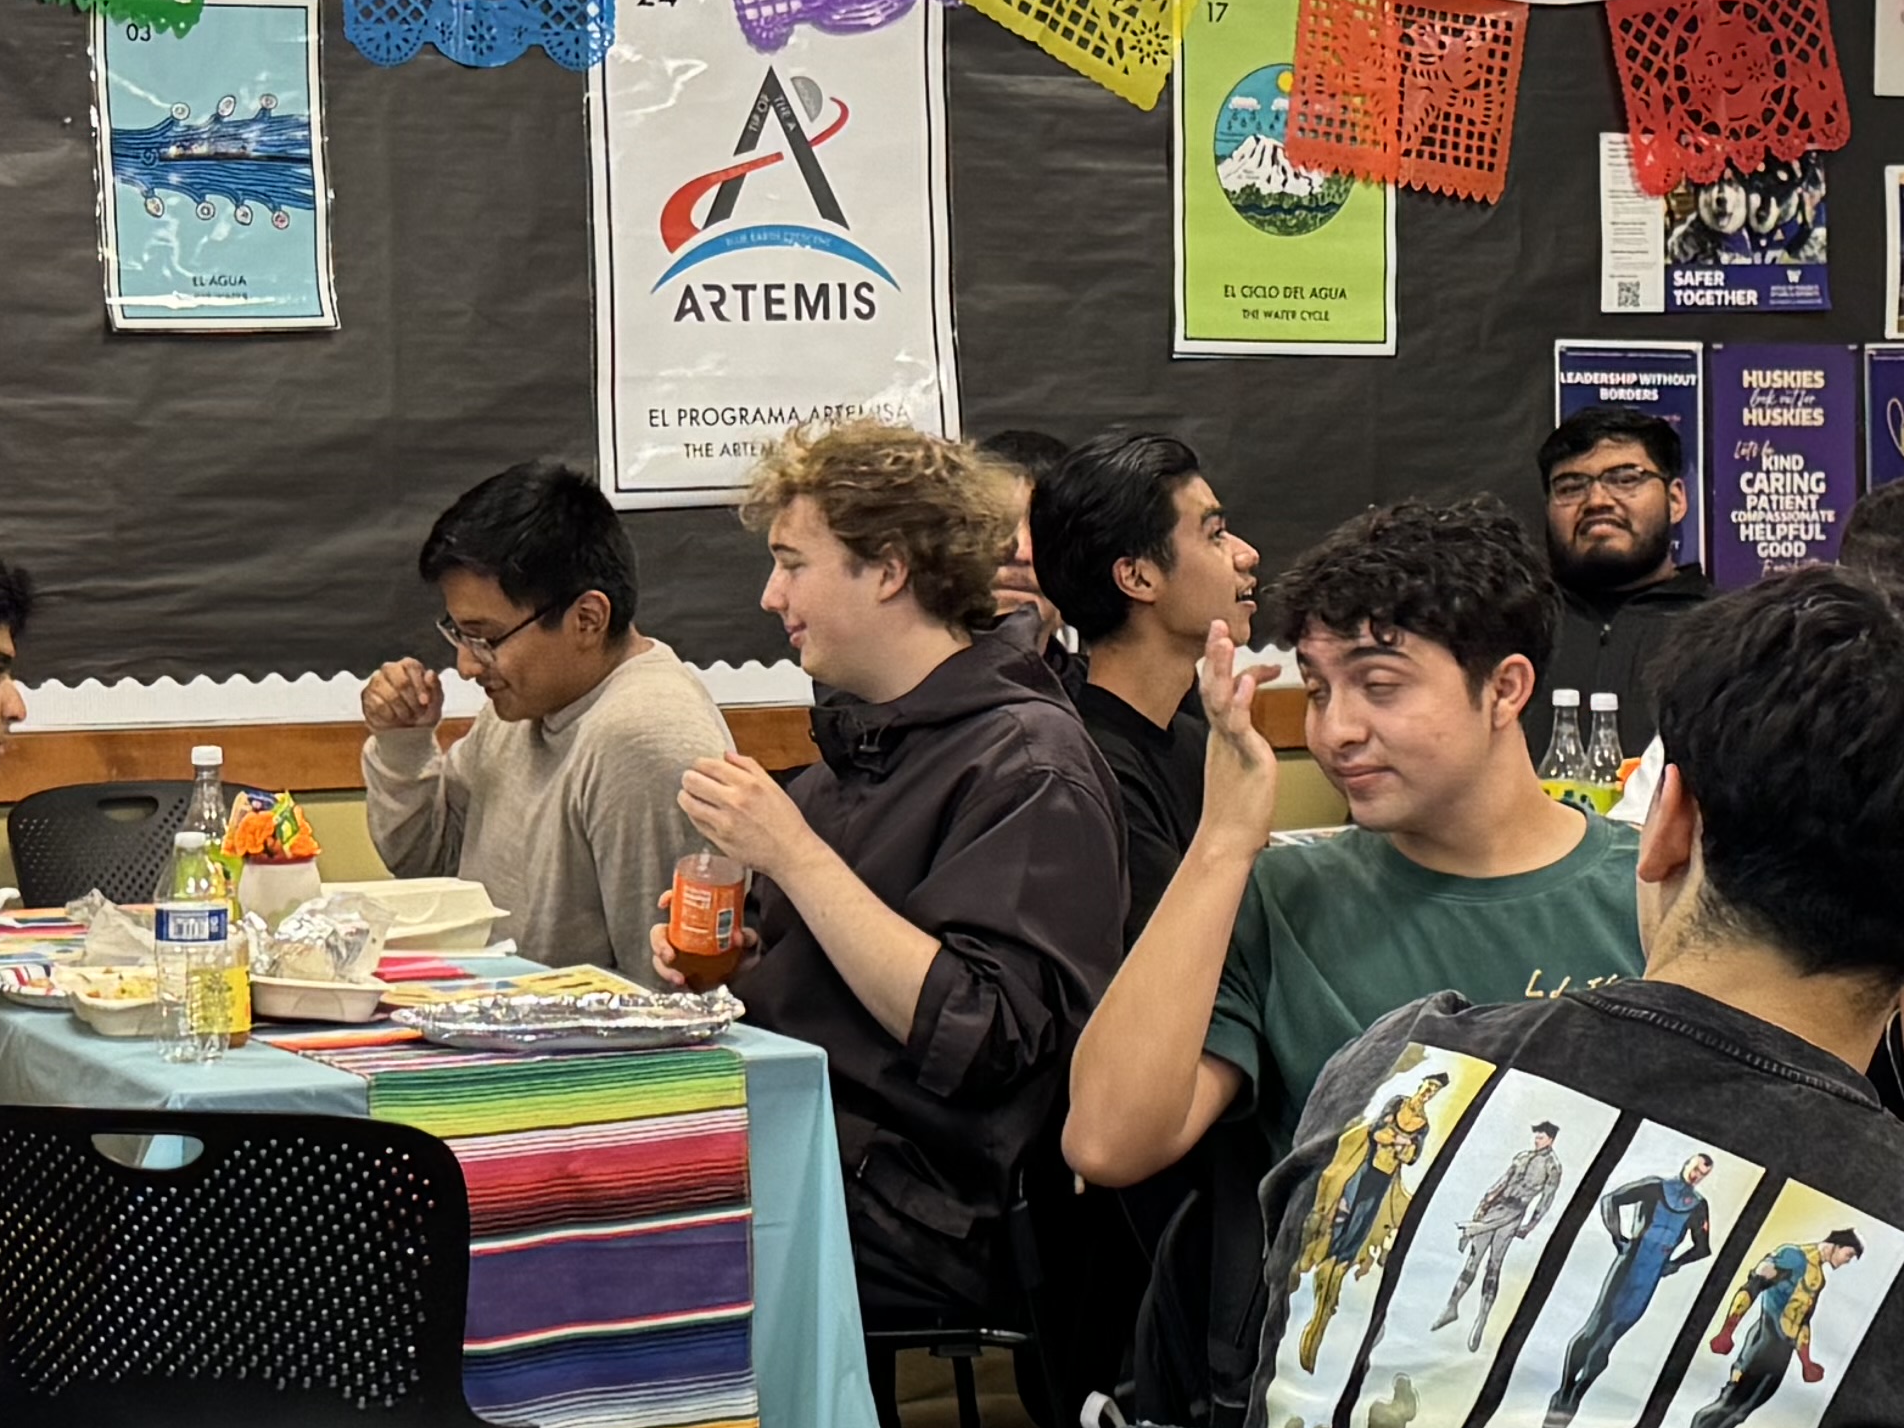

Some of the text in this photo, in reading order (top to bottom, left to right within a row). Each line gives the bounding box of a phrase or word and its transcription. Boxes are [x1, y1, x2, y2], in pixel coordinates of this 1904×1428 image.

[1207, 1, 1229, 24] 17
[126, 23, 152, 42] 03
[208, 275, 247, 287] AGUA
[1673, 270, 1725, 286] SAFER
[1224, 284, 1347, 300] EL CICLO DEL AGUA
[1673, 289, 1758, 306] TOGETHER
[673, 281, 876, 322] ARTEMIS
[1301, 310, 1330, 321] CYCLE
[1560, 372, 1696, 386] LEADERSHIP WITHOUT
[1742, 369, 1825, 389] HUSKIES
[1600, 388, 1659, 401] BORDERS
[649, 408, 669, 427] EL
[677, 406, 801, 426] PROGRAMA
[1742, 407, 1825, 426] HUSKIES
[684, 441, 713, 458] THE
[1762, 454, 1805, 471] KIND
[1739, 471, 1826, 494] CARING
[1746, 494, 1819, 510] PATIENT
[1730, 510, 1836, 523] COMPASSIONATE
[1739, 523, 1826, 541] HELPFUL
[1757, 541, 1807, 558] GOOD
